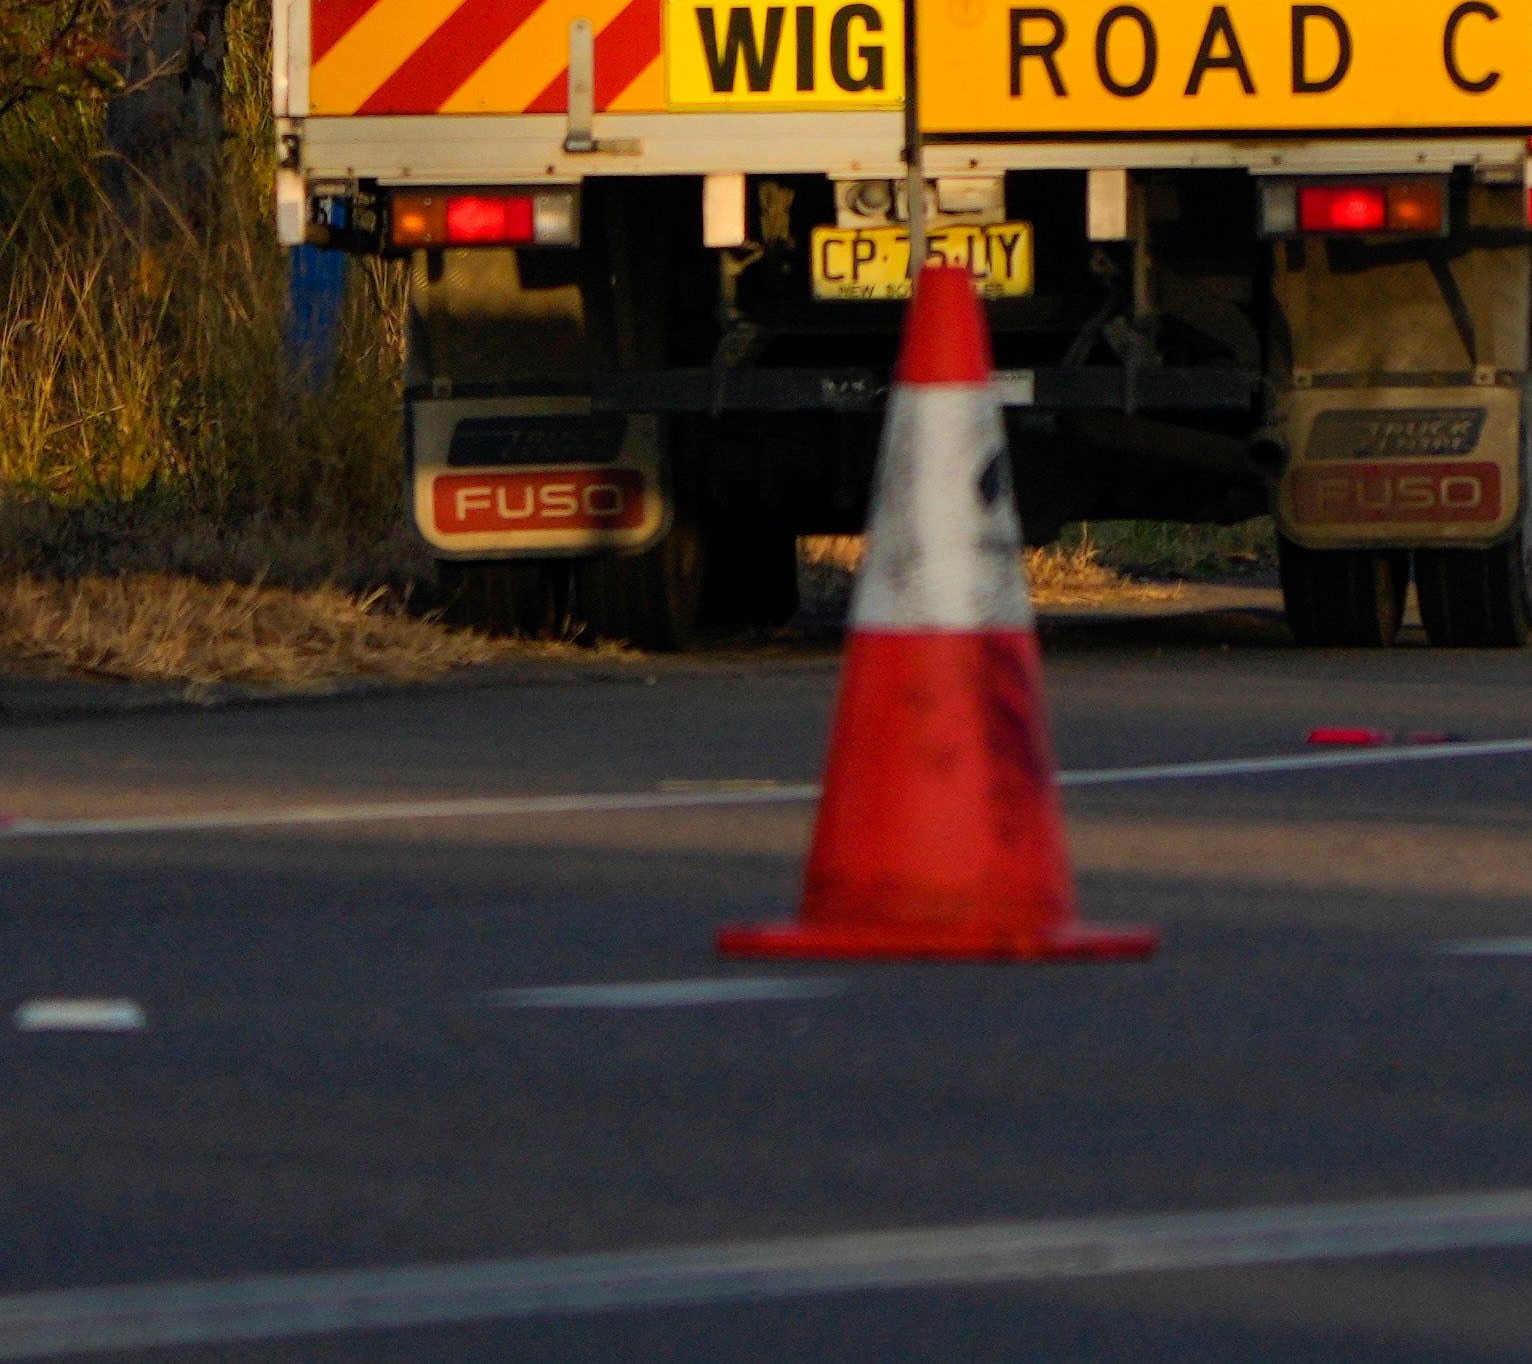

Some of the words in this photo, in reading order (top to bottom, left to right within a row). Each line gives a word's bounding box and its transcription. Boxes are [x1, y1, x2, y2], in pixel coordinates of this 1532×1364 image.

[694, 3, 886, 93] WIG
[1008, 4, 1354, 99] ROAD
[455, 482, 626, 521] FUSO
[1318, 475, 1483, 512] FUSO
